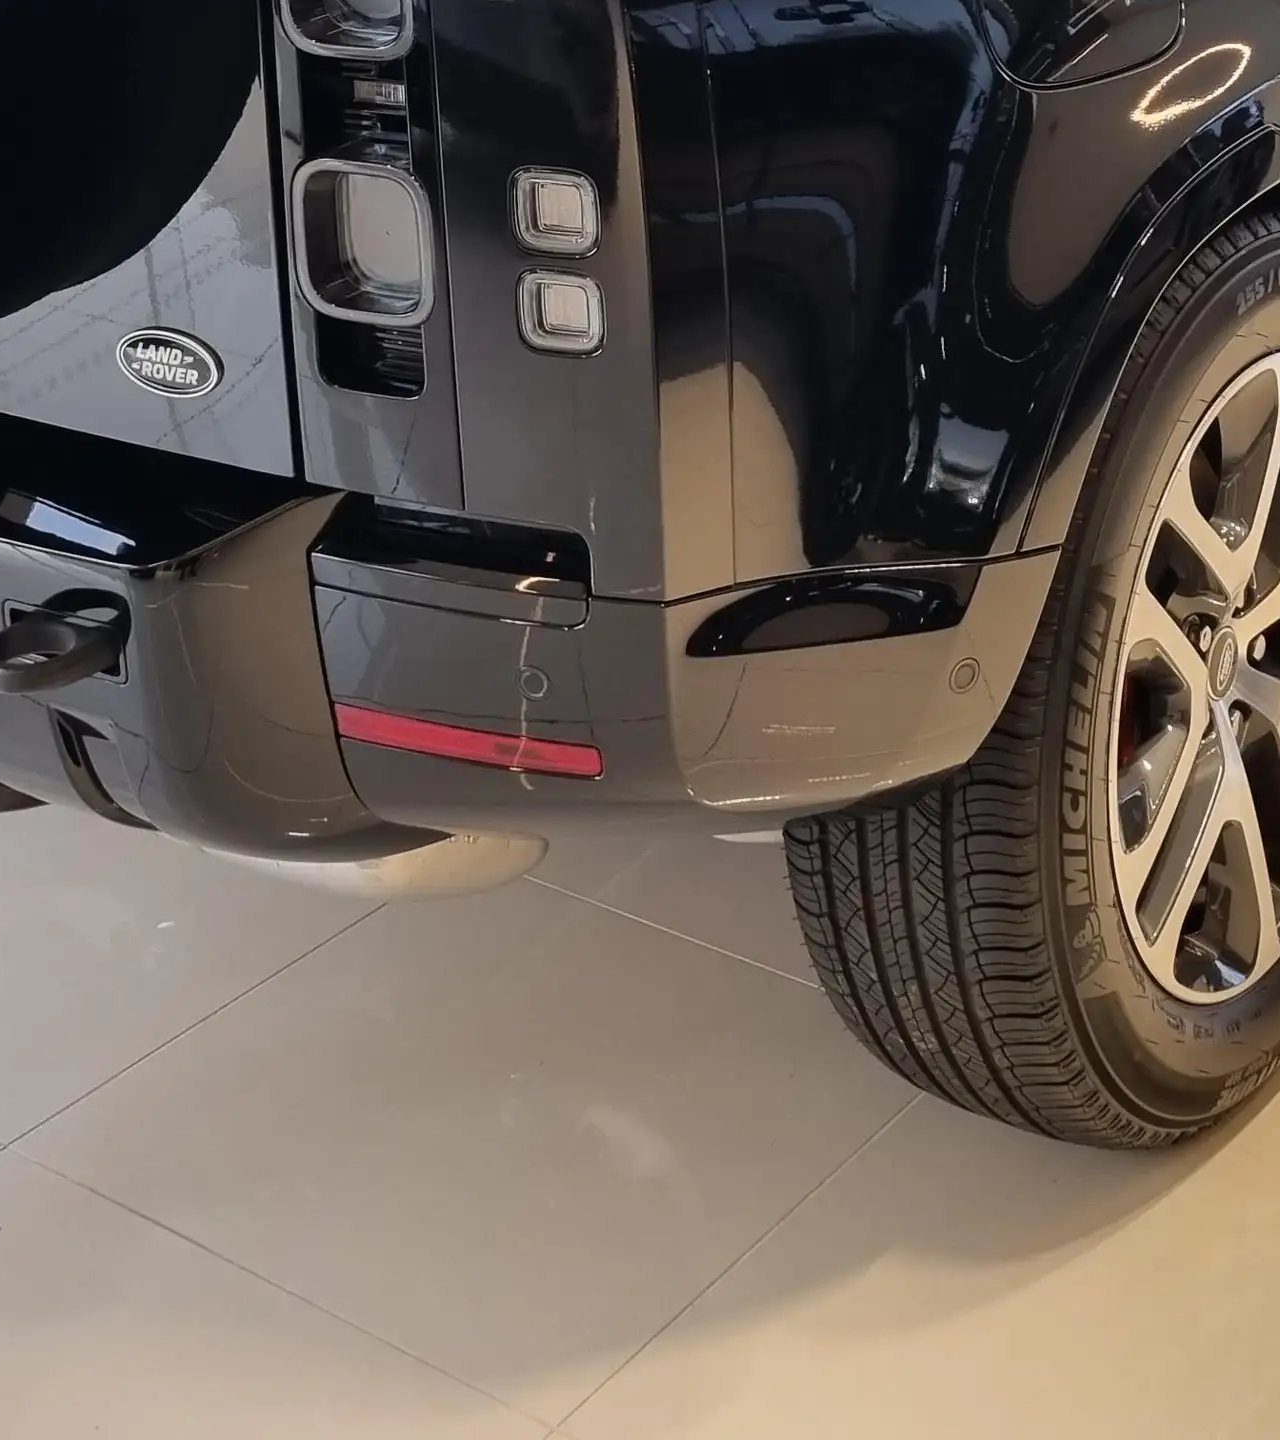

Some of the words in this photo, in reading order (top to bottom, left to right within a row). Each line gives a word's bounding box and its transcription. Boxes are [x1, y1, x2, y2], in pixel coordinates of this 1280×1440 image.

[135, 342, 183, 365] LAND
[141, 361, 199, 385] ROVER
[1061, 600, 1108, 907] MICHELIN
